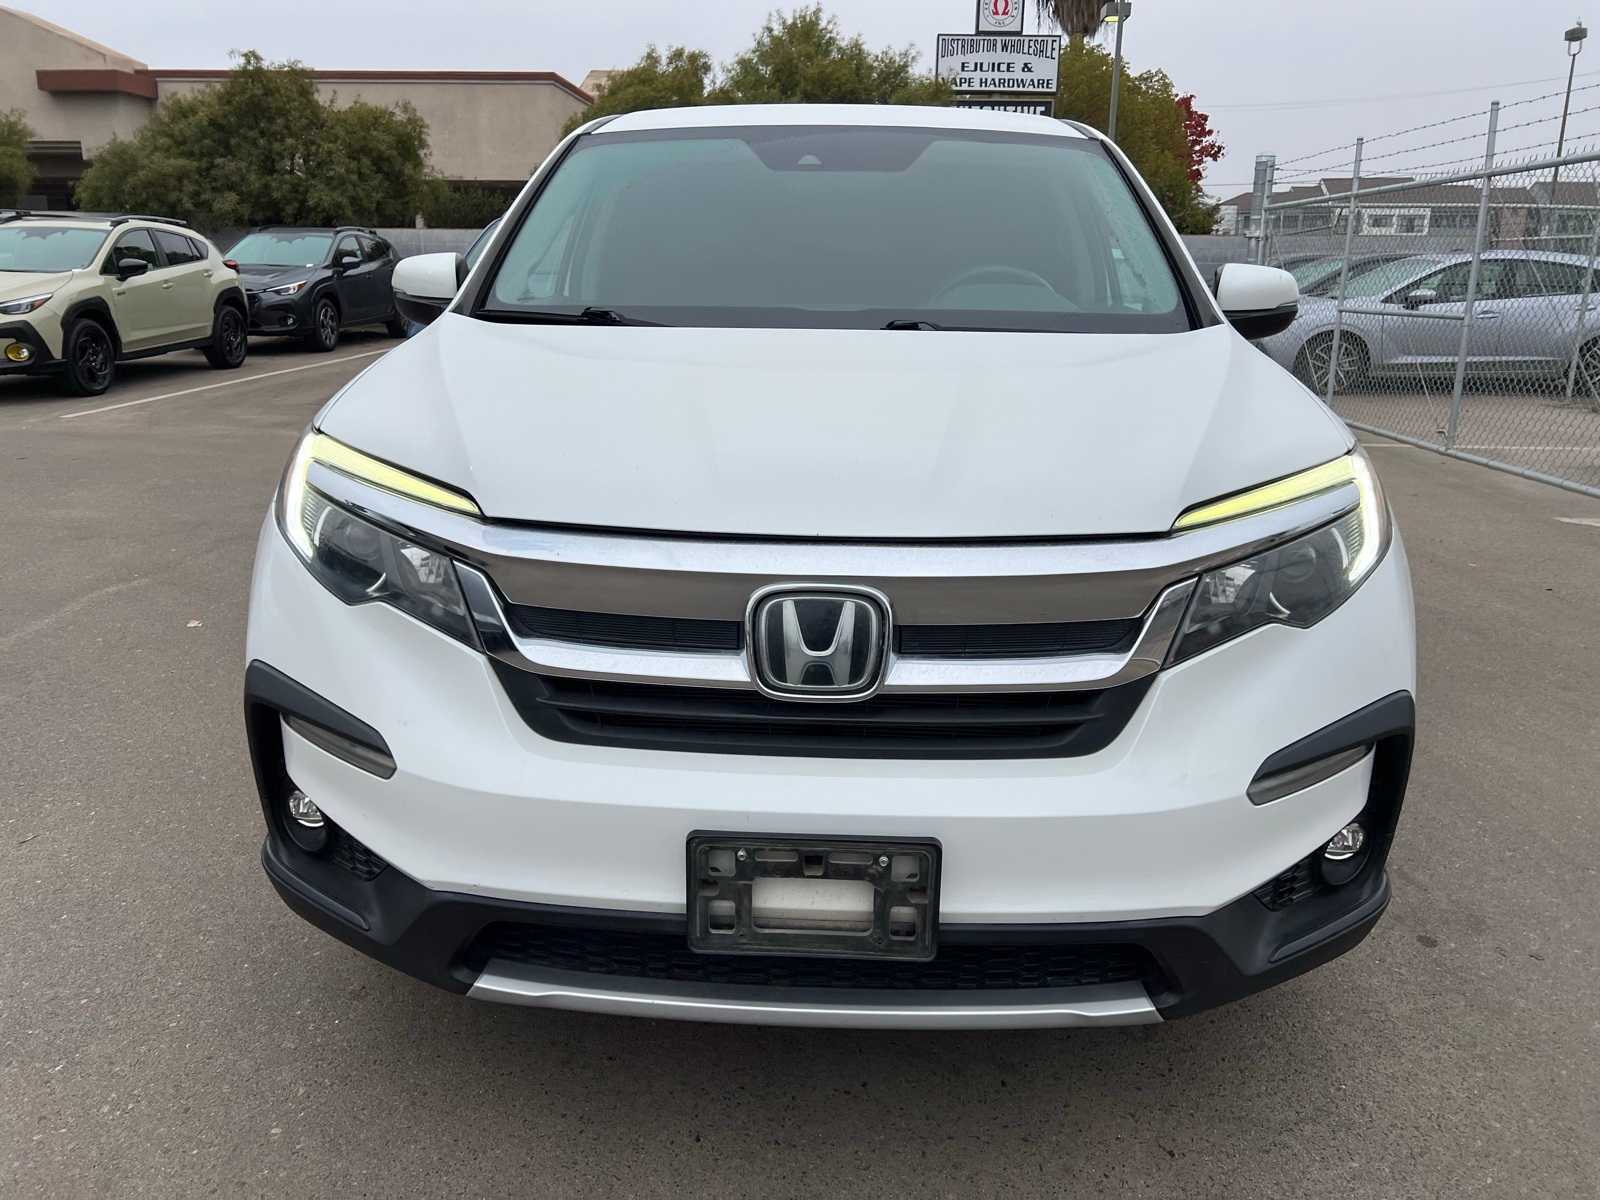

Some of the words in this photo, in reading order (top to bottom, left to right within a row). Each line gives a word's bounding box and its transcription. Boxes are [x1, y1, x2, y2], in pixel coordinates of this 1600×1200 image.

[941, 38, 997, 58] DISTRIBUTOR
[1001, 38, 1057, 60] WHOLESALE
[961, 62, 1015, 73] EJUICE
[1022, 62, 1034, 73] &
[941, 77, 975, 88] APE
[979, 78, 1053, 89] HARDWARE
